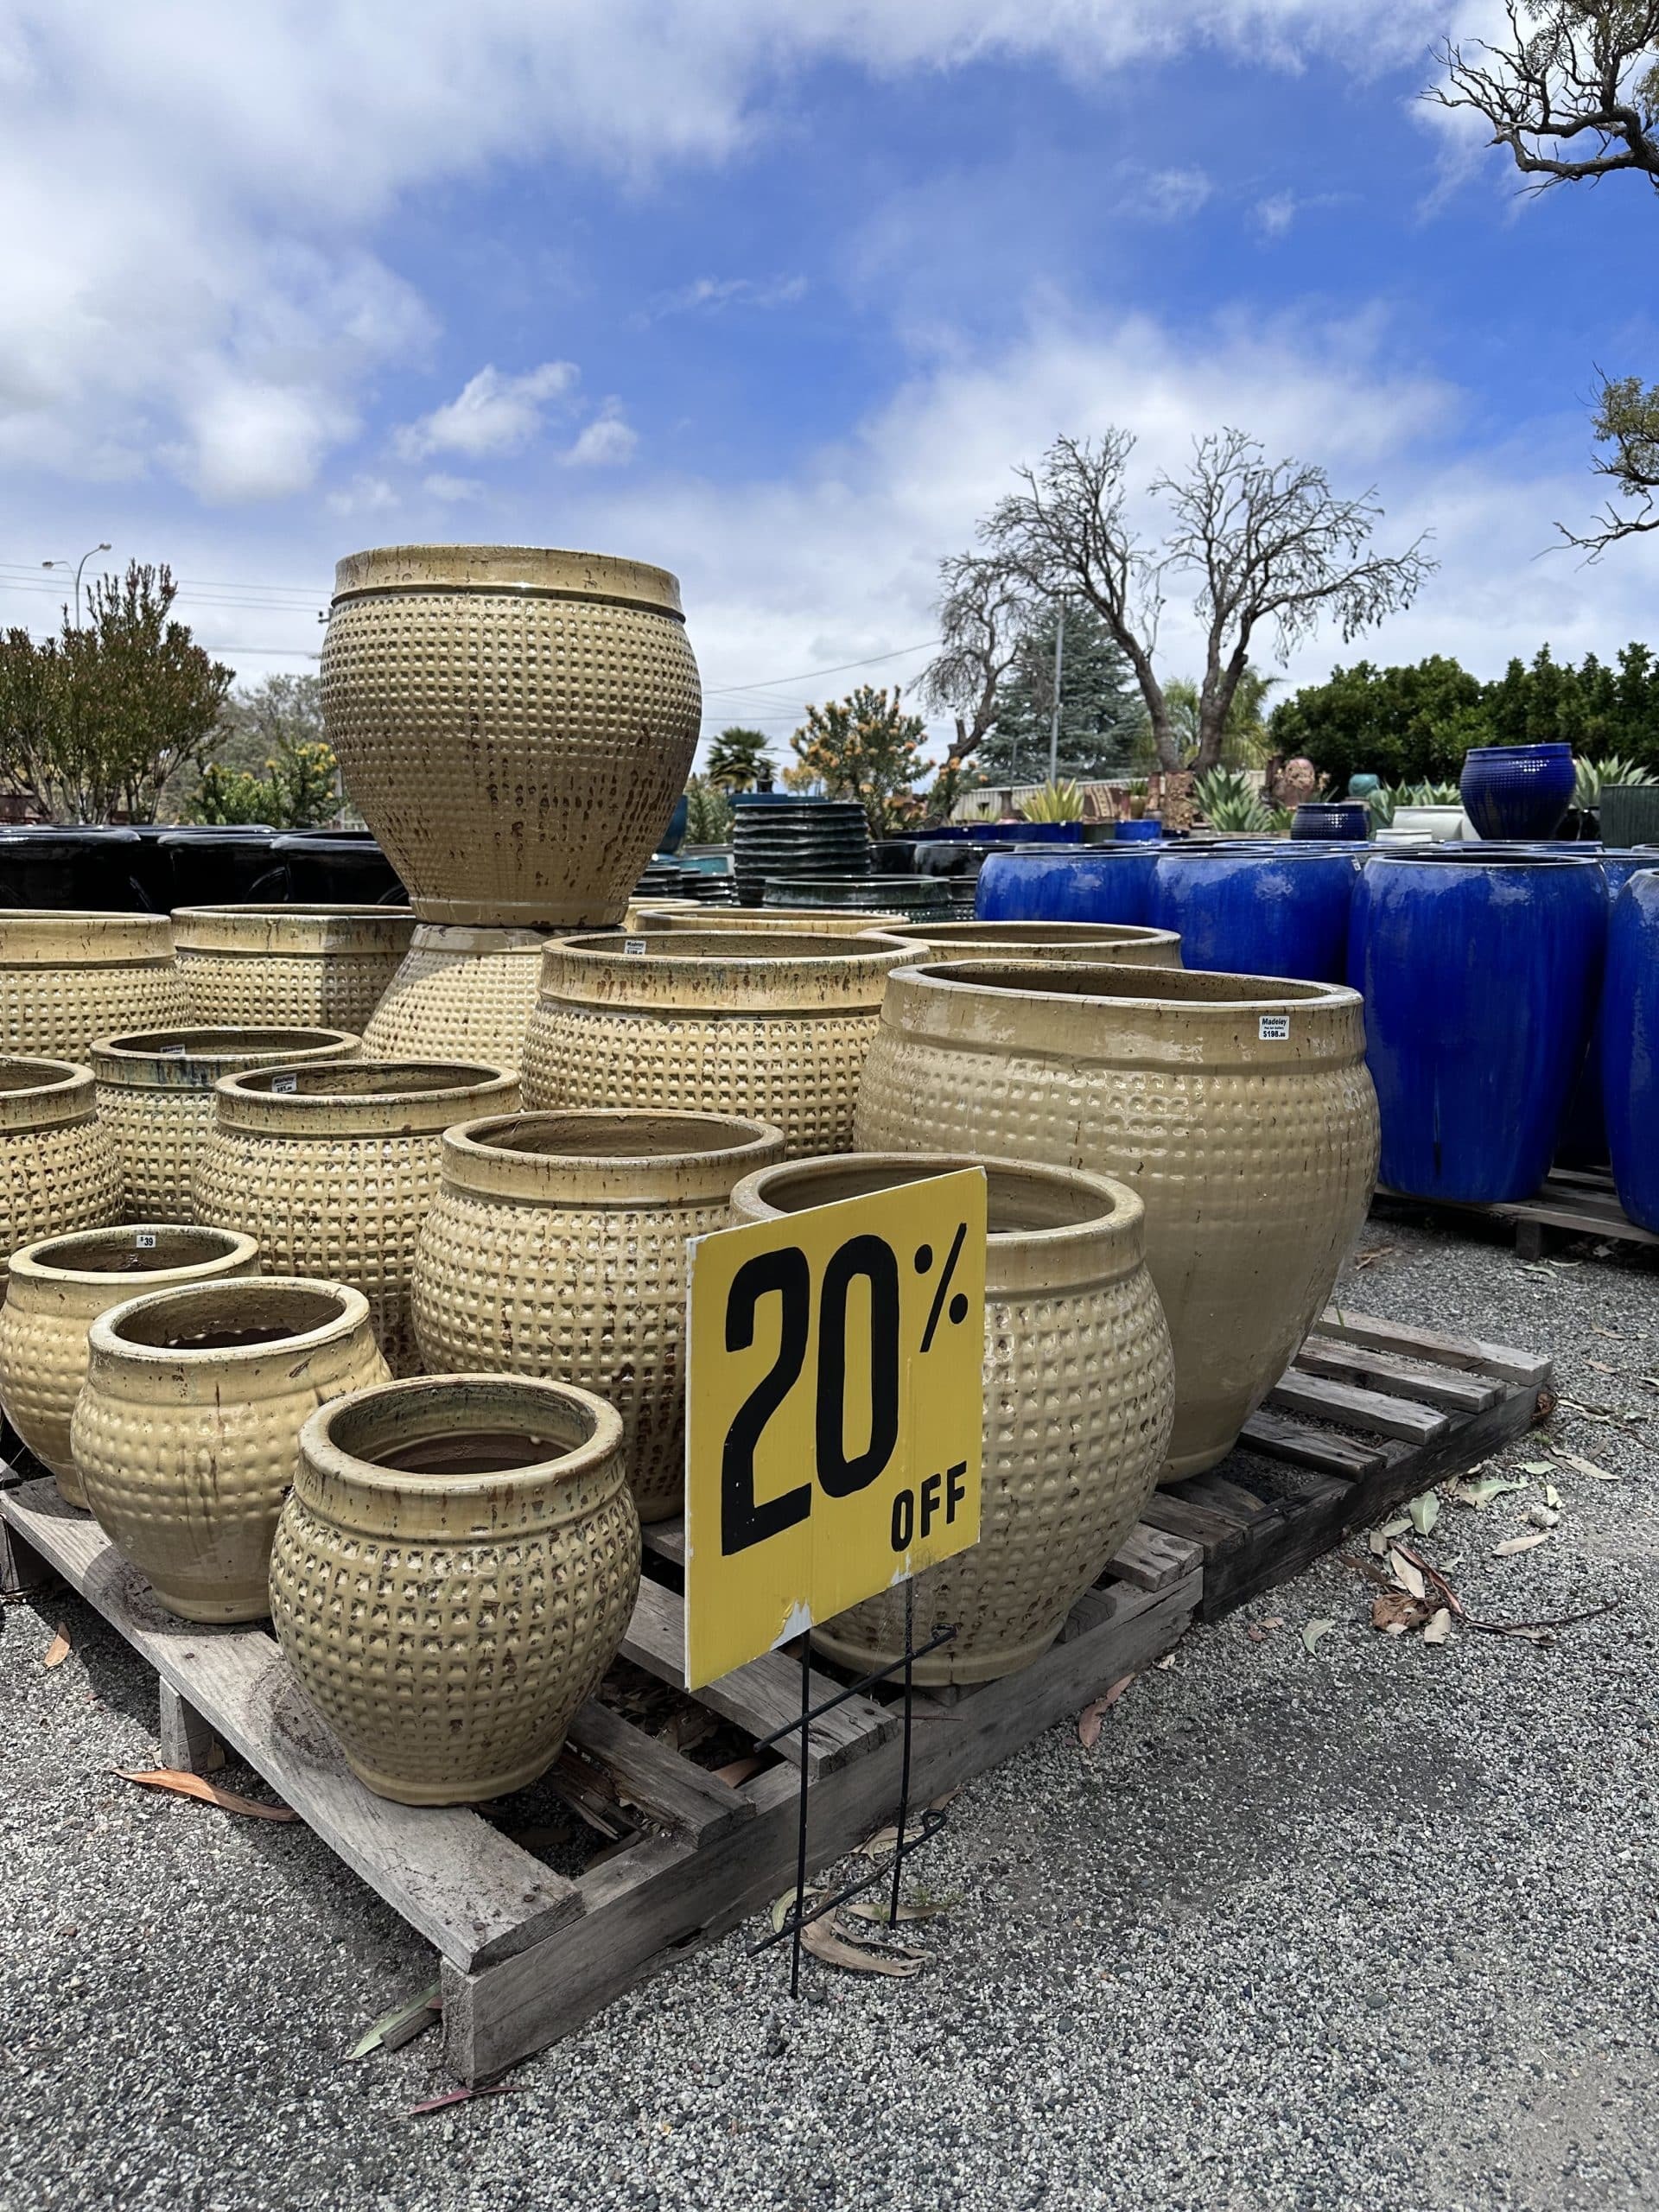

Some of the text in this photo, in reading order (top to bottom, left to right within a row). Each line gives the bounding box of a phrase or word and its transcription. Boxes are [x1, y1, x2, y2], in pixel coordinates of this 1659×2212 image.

[1262, 1018, 1287, 1027] Madeley
[721, 1223, 969, 1556] 20%
[890, 1460, 968, 1553] OFF
